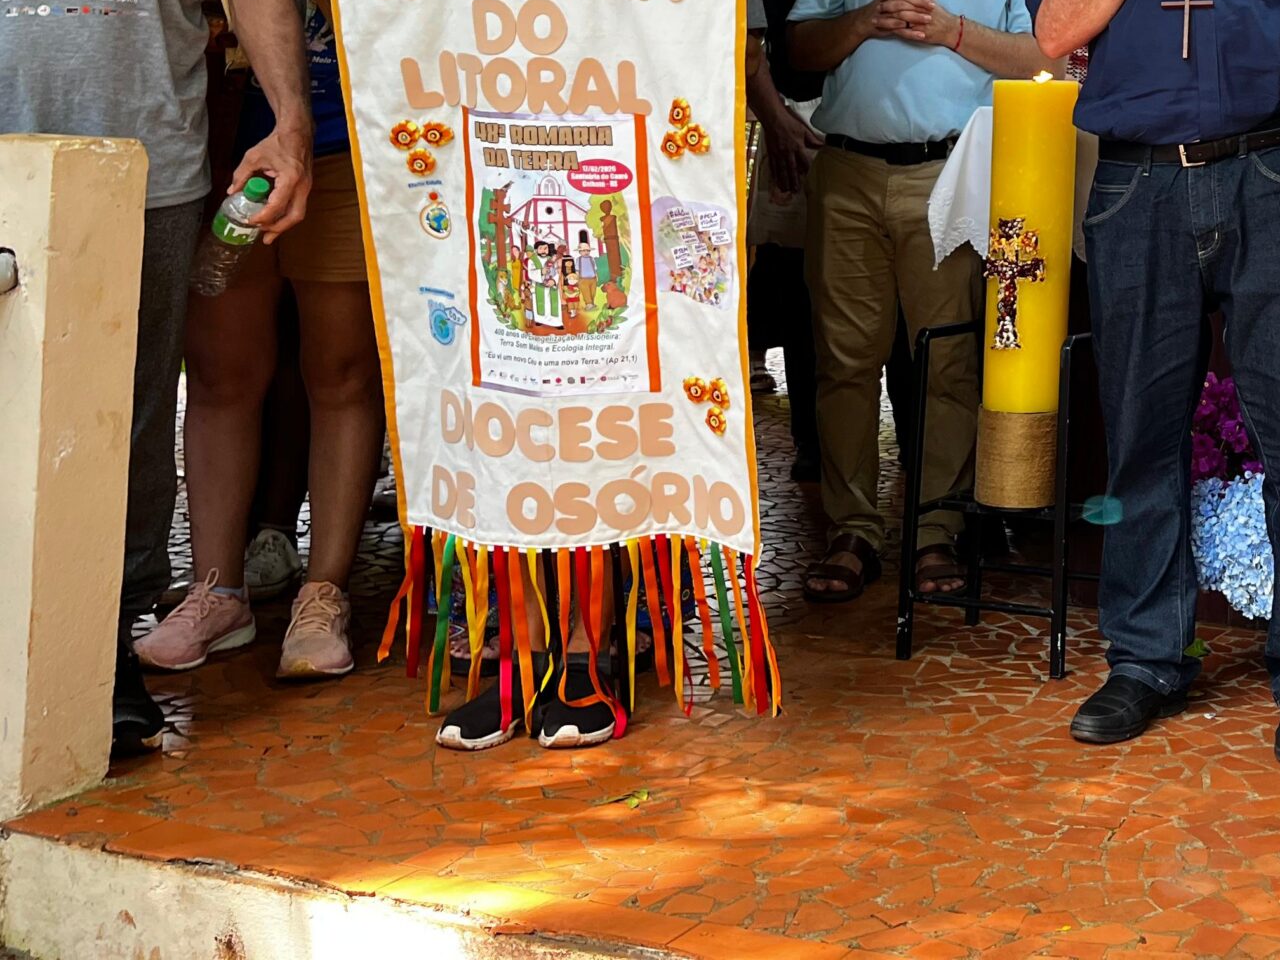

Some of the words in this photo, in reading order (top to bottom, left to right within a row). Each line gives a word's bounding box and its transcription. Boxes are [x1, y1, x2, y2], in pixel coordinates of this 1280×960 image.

[400, 50, 652, 116] LITORAL
[509, 125, 613, 147] ROMARIA
[483, 147, 509, 168] DA
[511, 149, 579, 171] TERRA
[552, 344, 583, 353] Ecologia
[440, 388, 677, 463] DIOCESE
[431, 464, 476, 529] DE
[506, 464, 745, 535] OSÓRIO
